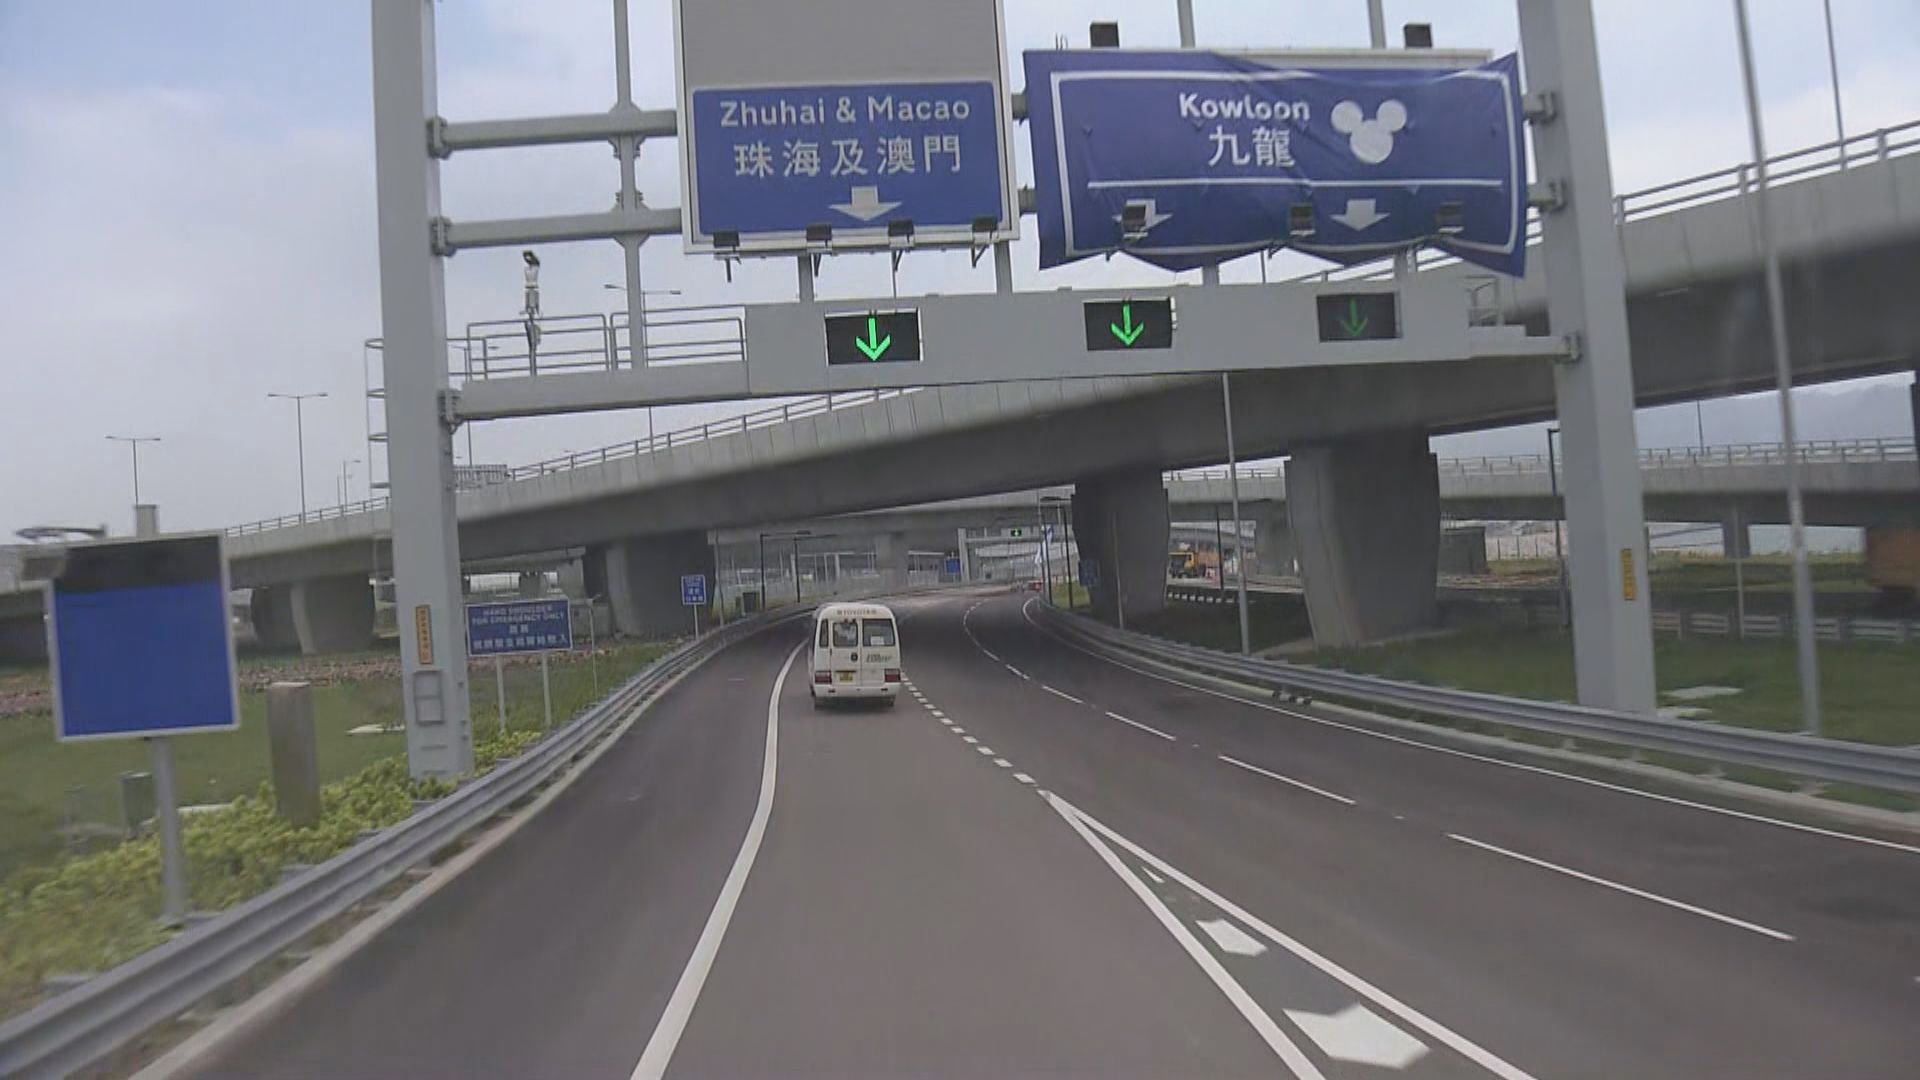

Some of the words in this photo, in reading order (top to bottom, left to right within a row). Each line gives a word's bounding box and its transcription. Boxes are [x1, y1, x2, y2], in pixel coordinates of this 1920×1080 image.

[720, 97, 825, 128] Zhuhai
[836, 96, 857, 123] &
[868, 95, 970, 123] Macao
[1179, 92, 1311, 121] Kowloon
[734, 134, 961, 178] 珠海及澳門
[1208, 125, 1295, 168] 九龍
